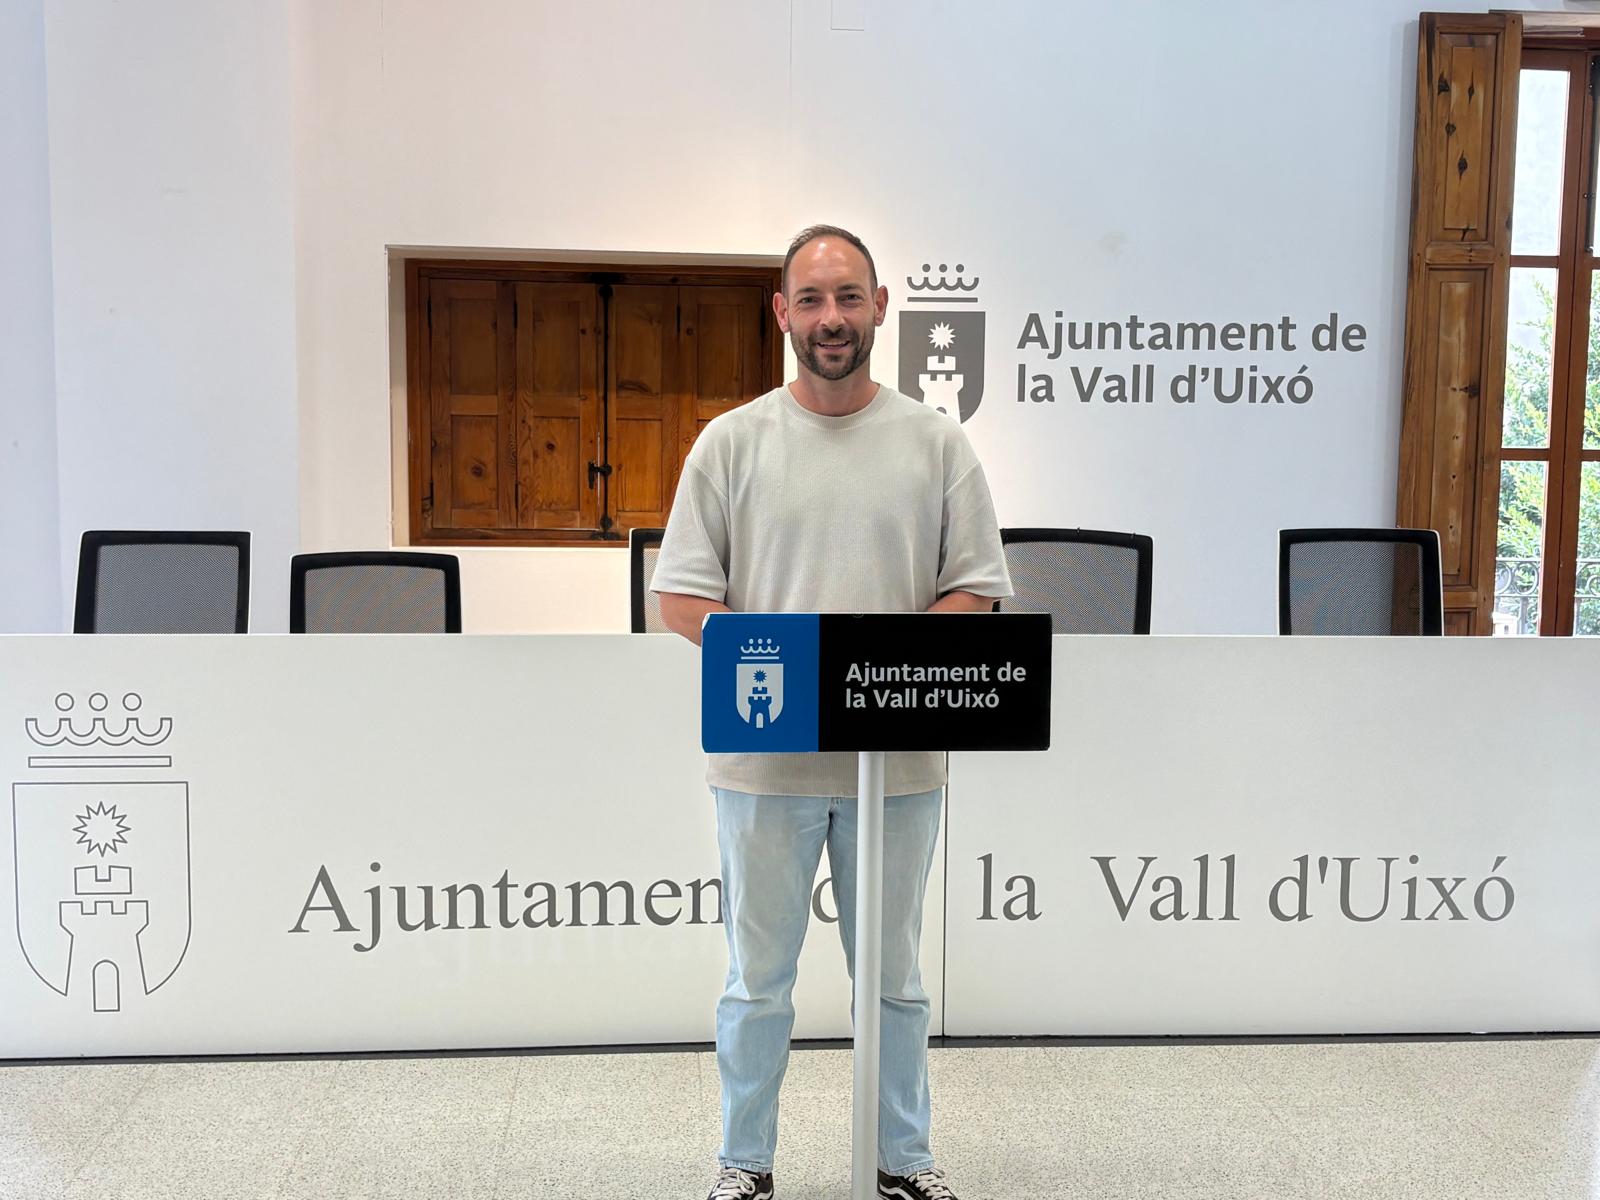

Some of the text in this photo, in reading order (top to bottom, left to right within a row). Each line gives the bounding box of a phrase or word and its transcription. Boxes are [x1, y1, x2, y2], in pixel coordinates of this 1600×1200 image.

[1017, 311, 1366, 359] Ajuntament de
[1018, 364, 1313, 404] la Vall d’Uixó
[845, 661, 1027, 687] Ajuntament de
[846, 687, 1000, 708] la Vall d’Uixó
[288, 853, 1515, 952] Ajuntamen la Vall d'Uixó
